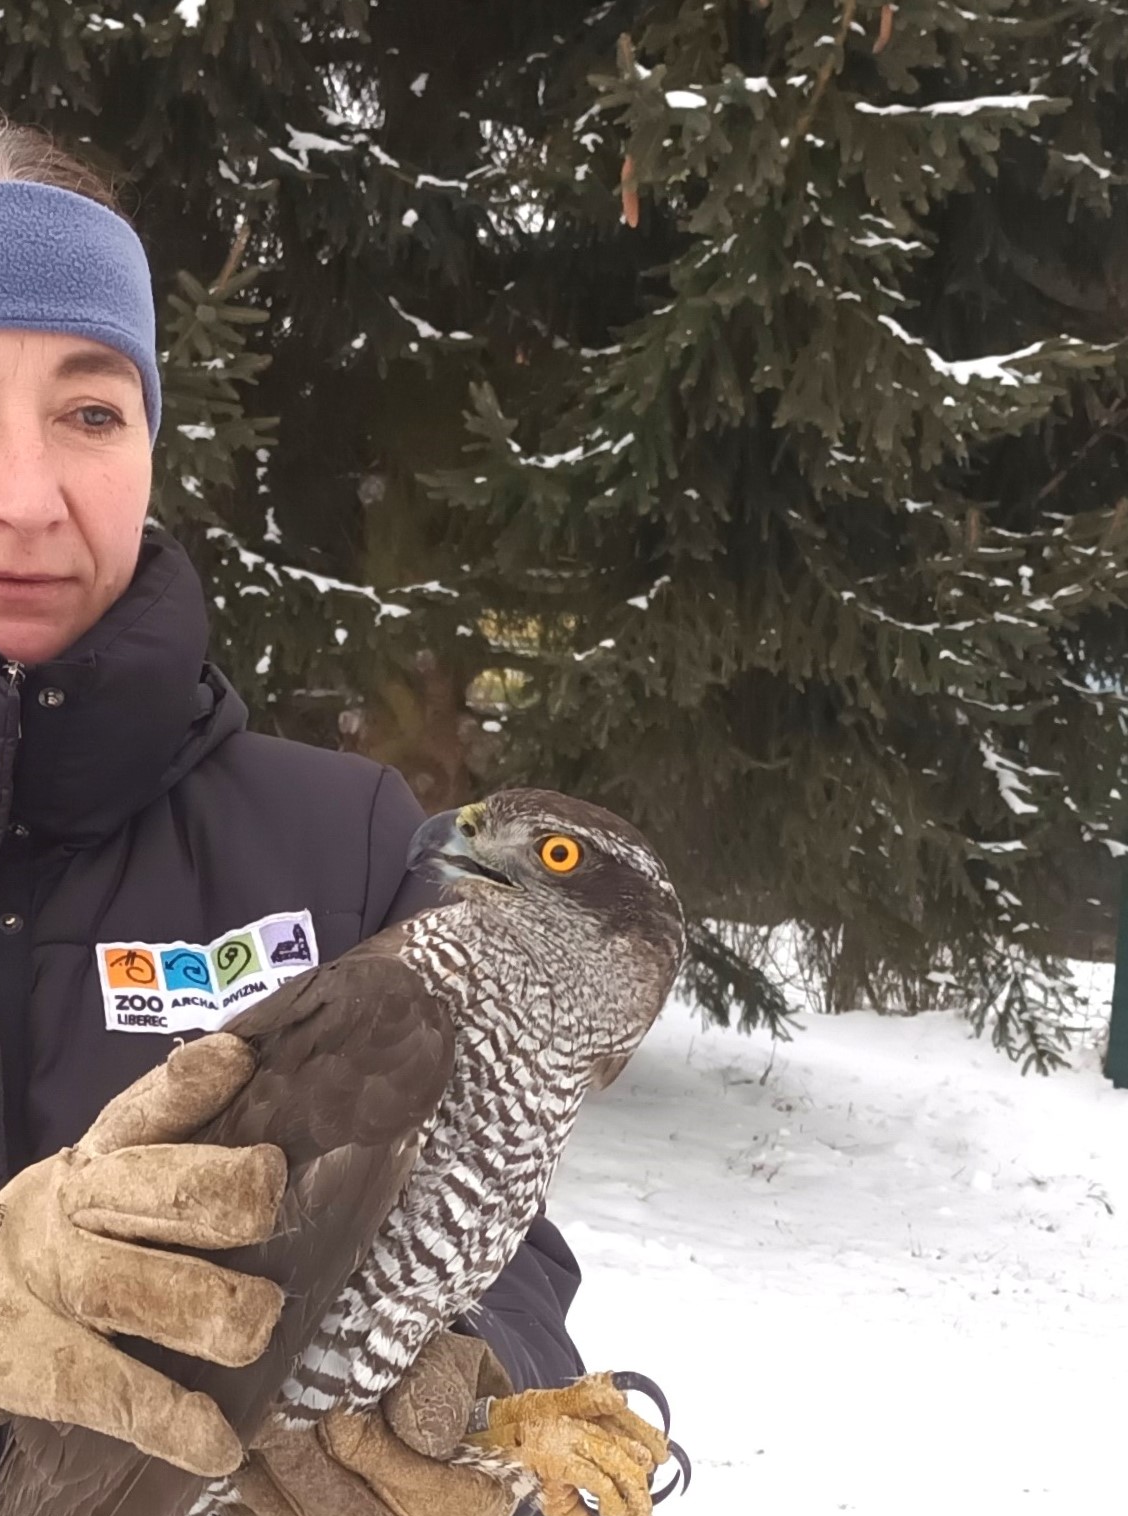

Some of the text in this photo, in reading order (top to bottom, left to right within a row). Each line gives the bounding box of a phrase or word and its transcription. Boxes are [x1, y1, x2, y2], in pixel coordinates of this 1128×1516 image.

[222, 980, 268, 1008] DIVIZNA
[114, 994, 164, 1012] ZOO
[171, 996, 219, 1011] ARCHA
[117, 1013, 169, 1028] LIBEREC
